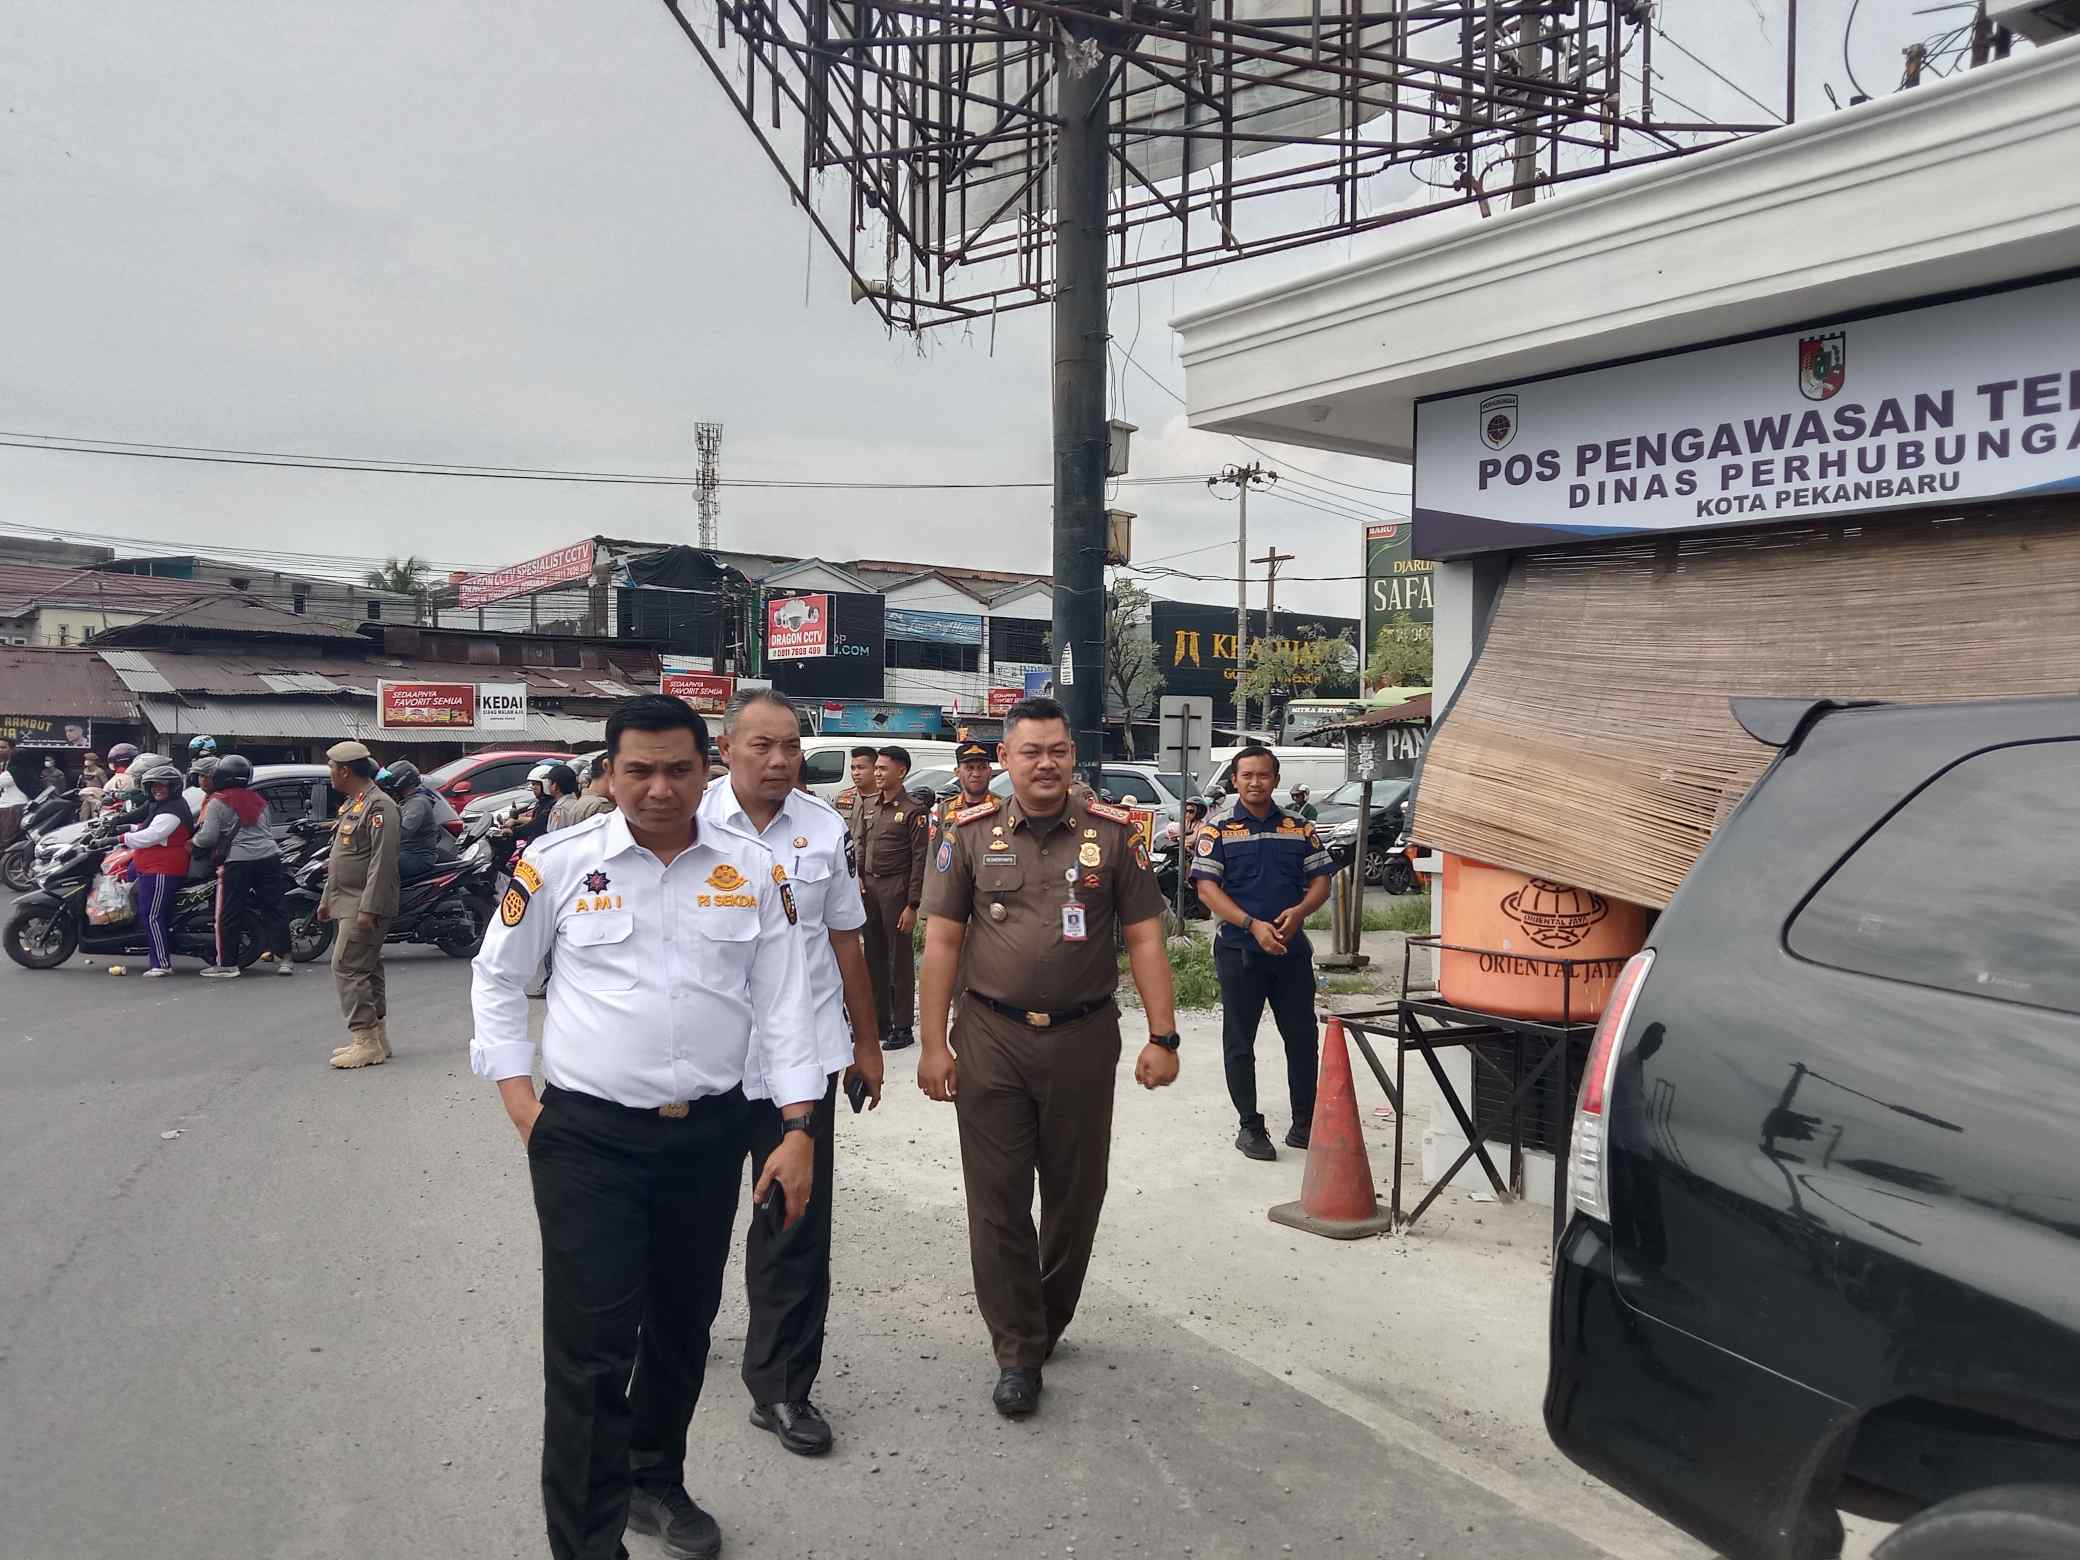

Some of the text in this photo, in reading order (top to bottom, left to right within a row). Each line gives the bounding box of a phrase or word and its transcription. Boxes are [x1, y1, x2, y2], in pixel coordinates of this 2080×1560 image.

[1478, 369, 2080, 491] POS PENGAWASAN TE
[1568, 468, 1698, 509] DINAS
[1696, 470, 1960, 518] KOTA PEKANBARU
[565, 543, 590, 563] CCTV
[771, 630, 823, 647] DRAGON CCTV
[670, 687, 724, 695] FAVORIT SEMUA
[394, 697, 463, 707] FAVORIT SEMUA
[482, 696, 523, 709] KEDAI
[1524, 914, 1565, 926] ORIENTAL
[1479, 953, 1580, 979] ORIENTAL
